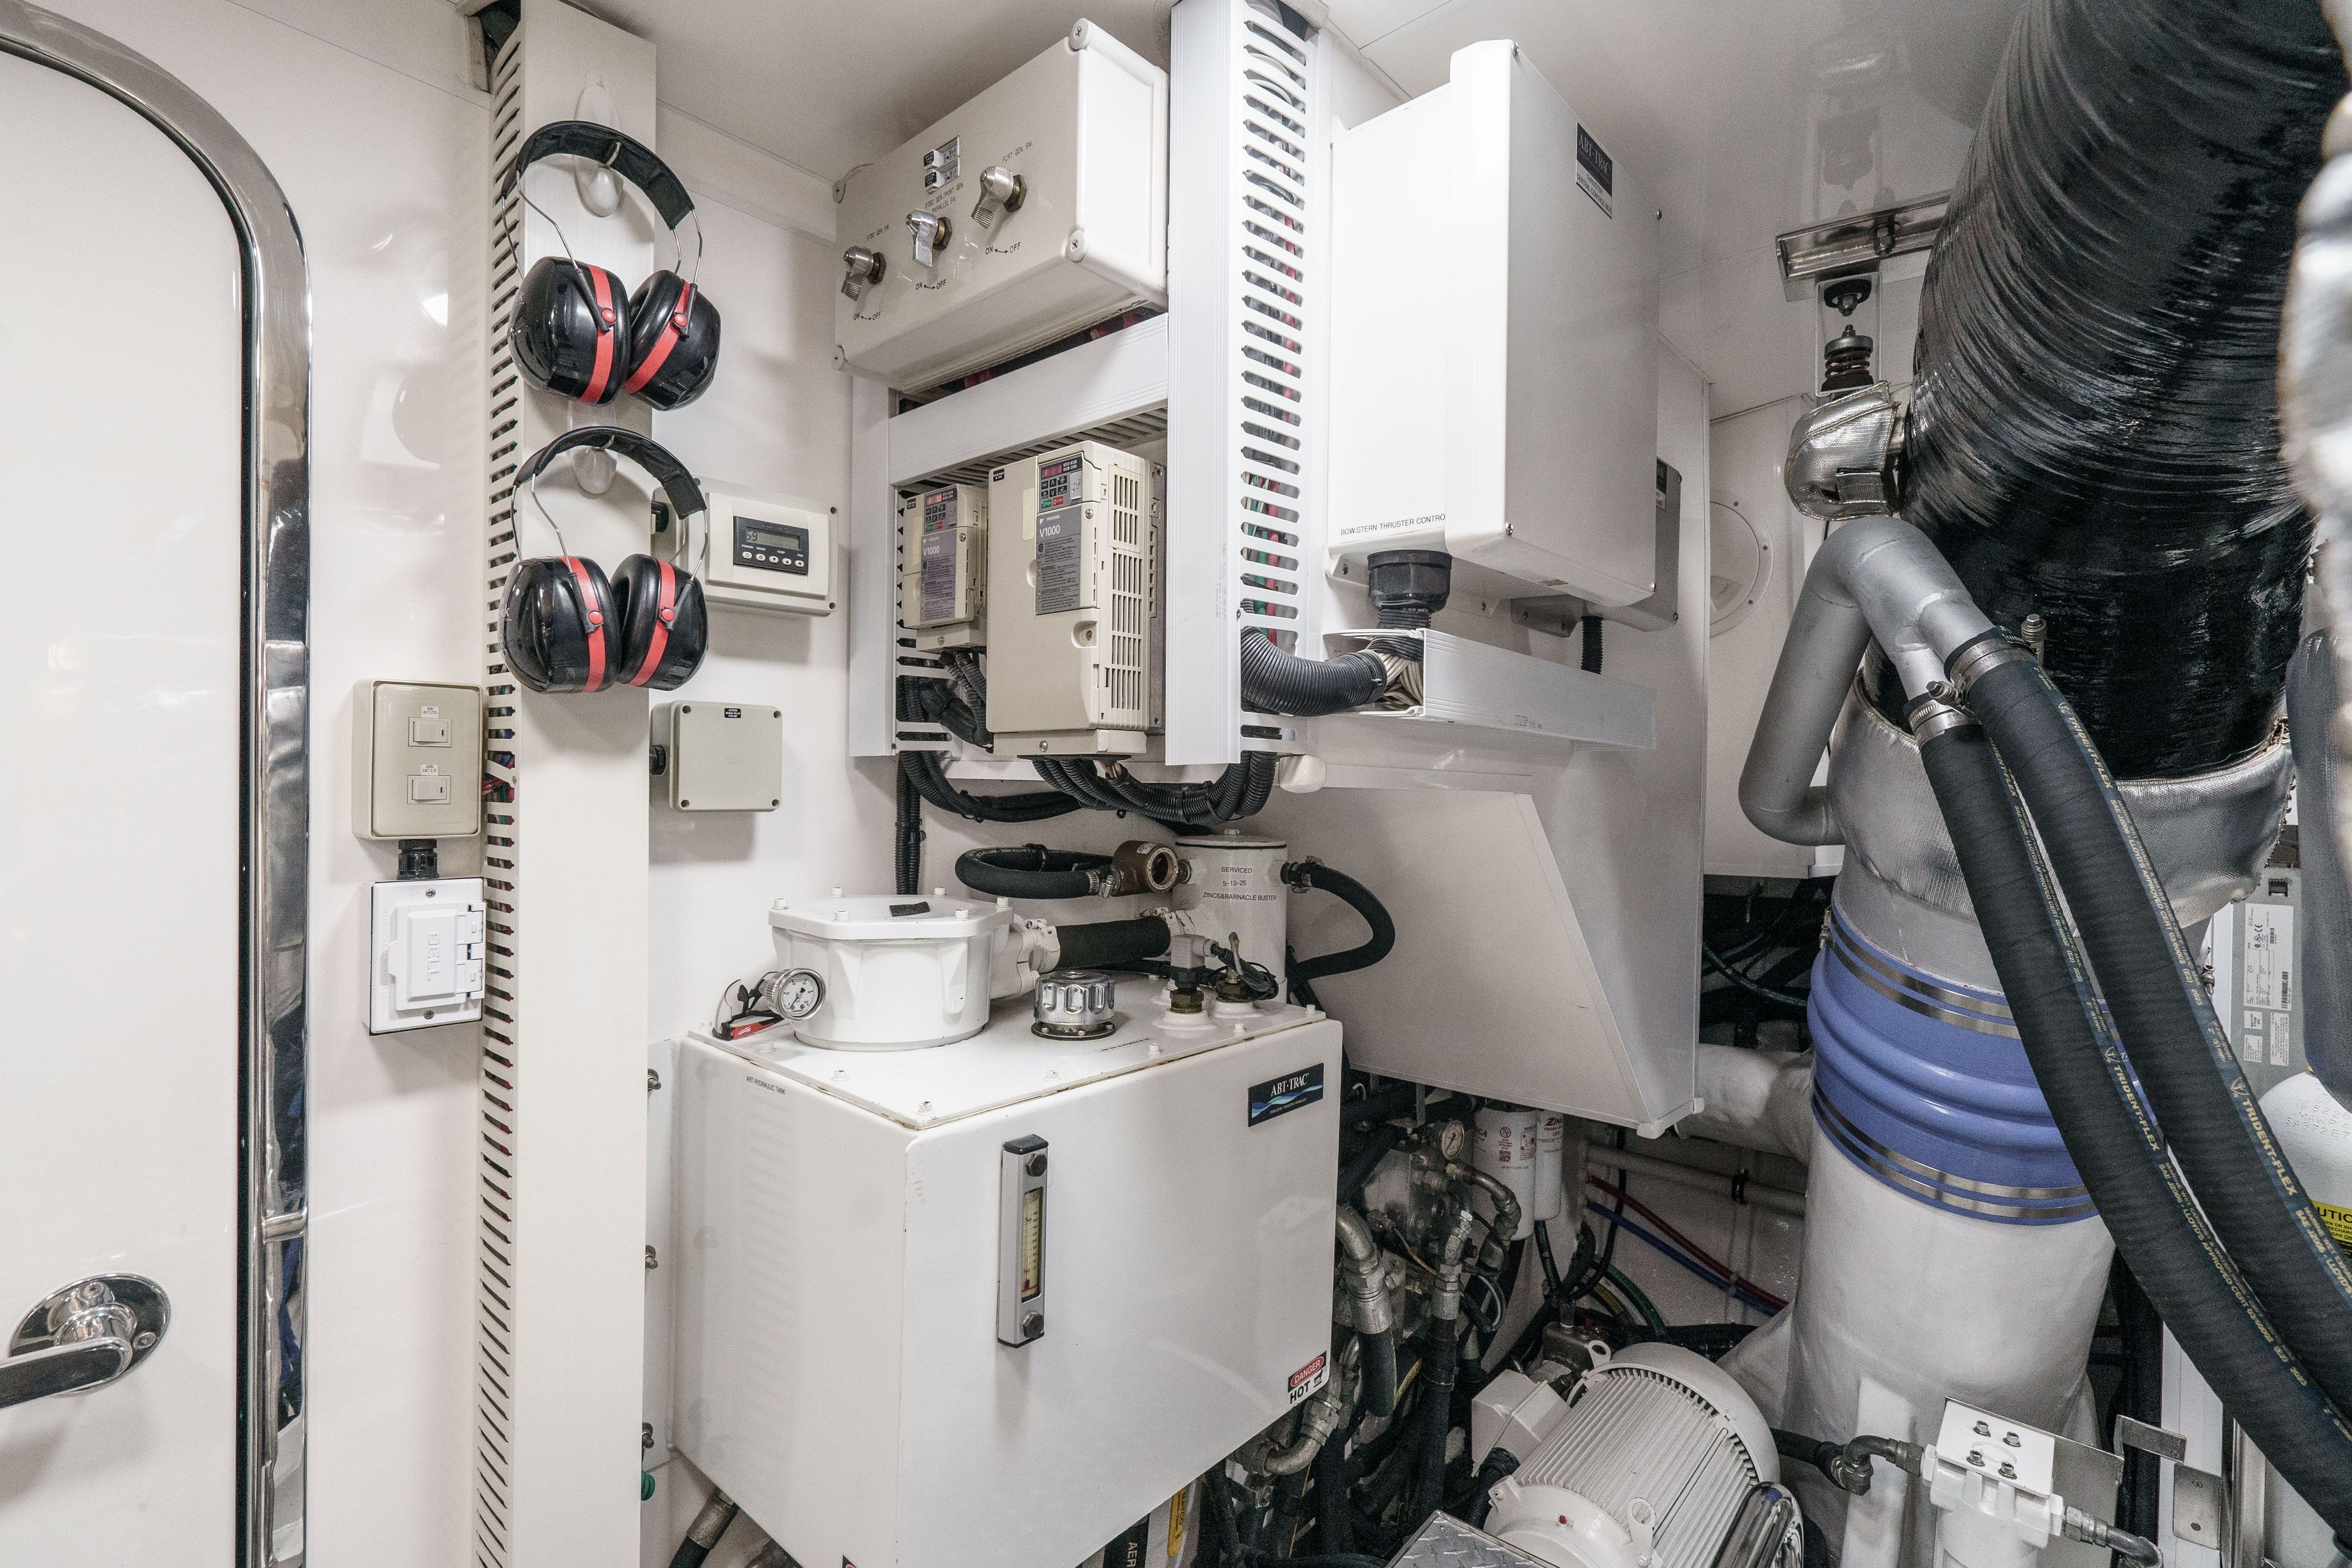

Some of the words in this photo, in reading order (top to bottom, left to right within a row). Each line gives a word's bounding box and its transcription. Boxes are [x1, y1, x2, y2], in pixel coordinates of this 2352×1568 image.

[1002, 153, 1014, 163] PORT
[932, 201, 949, 214] PARALLEL
[1591, 186, 1605, 208] CONTROL
[985, 246, 993, 255] ON
[1009, 241, 1021, 254] OFF
[915, 282, 923, 290] ON
[936, 279, 947, 290] OFF
[853, 312, 861, 321] ON
[872, 311, 881, 321] OFF
[1039, 524, 1061, 538] V1000
[1341, 524, 1378, 536] BOW/STERN
[1379, 518, 1414, 530] THRUSTER
[1416, 513, 1446, 524] CONTRO
[923, 545, 940, 556] V1000
[2068, 715, 2114, 789] TRIDENT-FLEX
[1990, 737, 2018, 797] IDENT-FLEX
[2110, 799, 2121, 813] SAE
[2143, 870, 2164, 910] APPROVED
[2160, 910, 2174, 931] CERT
[1203, 892, 1256, 900] ZINCS&BARNACLE
[2035, 865, 2052, 900] APPROVED
[2048, 900, 2059, 919] CERT
[2066, 950, 2076, 963] (E2)
[427, 932, 440, 981] BELL
[754, 1078, 775, 1091] HYDRAULIC
[775, 1086, 786, 1095] TANK
[2114, 1065, 2160, 1152] TRIDENT-FLEX
[2242, 1098, 2299, 1196] TRIDENT-FLEX
[2159, 1164, 2171, 1180] SAE
[2202, 1242, 2233, 1285] APPROVED
[2317, 1207, 2352, 1223] UTIO
[1294, 1360, 1321, 1385] DANGER
[1290, 1380, 1310, 1404] HOT
